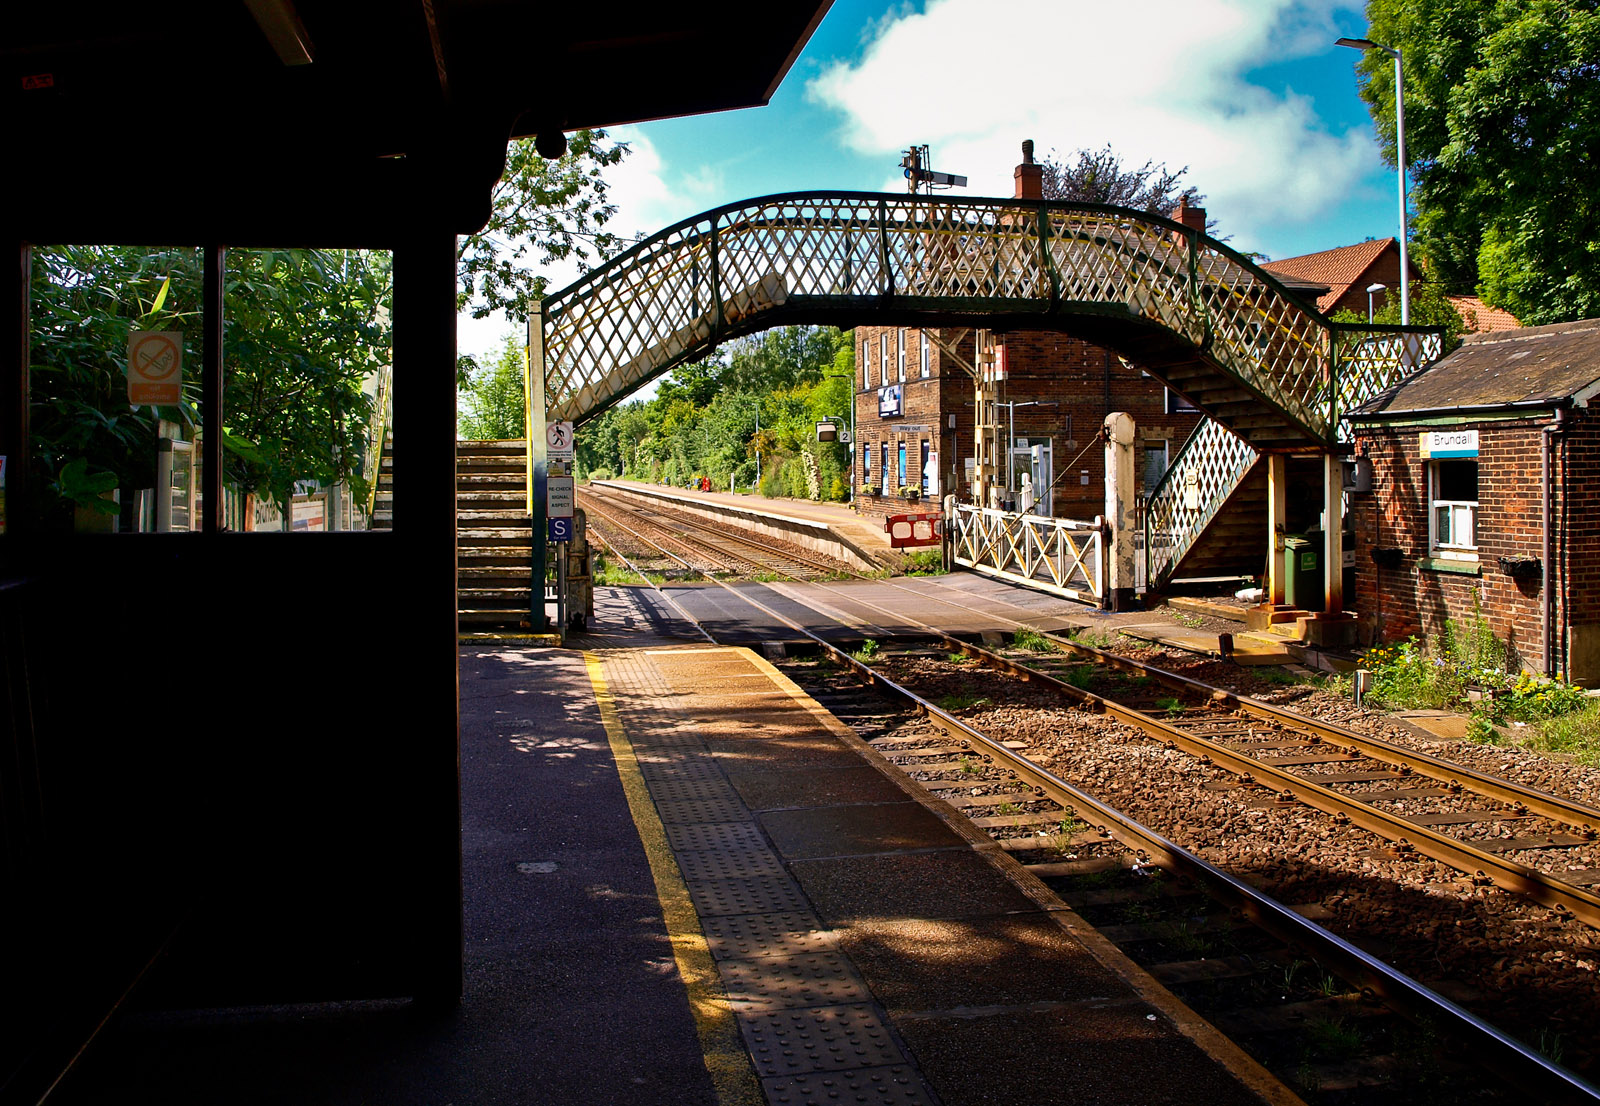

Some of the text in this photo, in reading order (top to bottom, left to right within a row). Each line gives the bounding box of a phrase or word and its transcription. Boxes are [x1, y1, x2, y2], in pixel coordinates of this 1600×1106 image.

[842, 432, 848, 440] 2
[1434, 433, 1472, 445] Brundall
[554, 520, 566, 535] S
